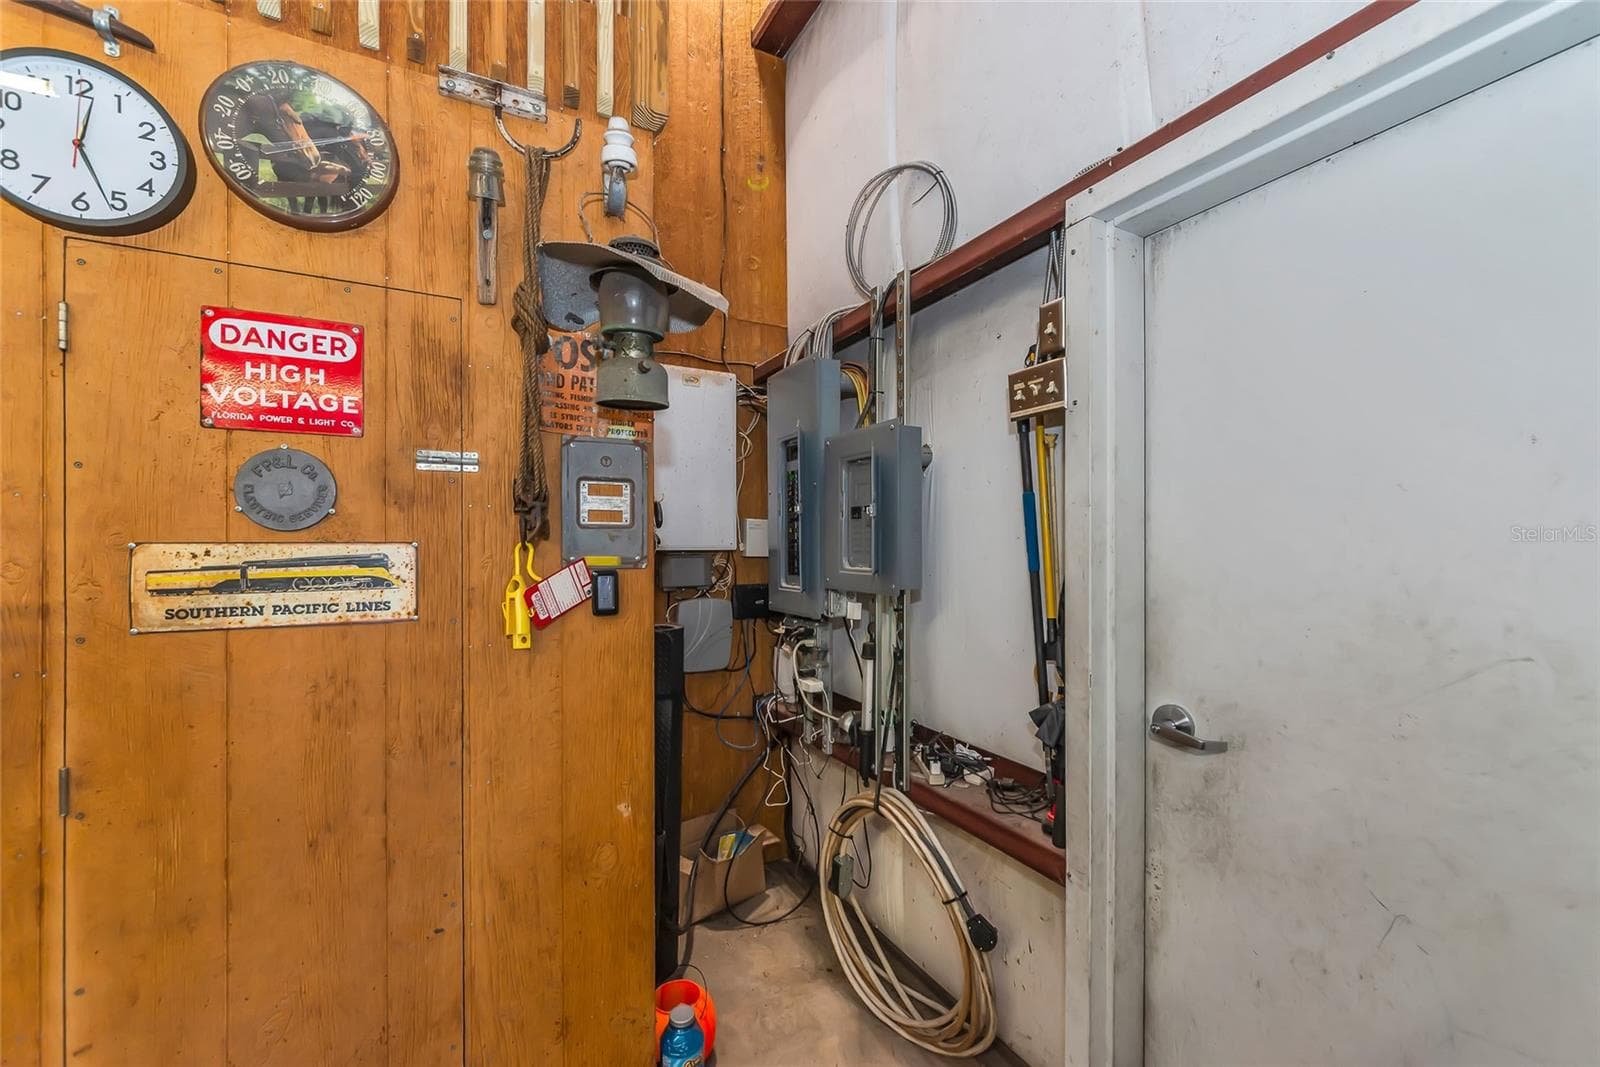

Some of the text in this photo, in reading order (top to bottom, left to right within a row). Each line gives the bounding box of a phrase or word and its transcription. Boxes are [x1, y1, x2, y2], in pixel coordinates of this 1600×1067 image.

[65, 75, 94, 96] 12
[268, 68, 290, 84] 20
[114, 94, 122, 113] 1
[138, 121, 156, 141] 2
[0, 149, 20, 170] 8
[149, 150, 167, 170] 3
[370, 161, 387, 184] 100
[31, 173, 51, 194] 7
[136, 178, 155, 197] 4
[71, 191, 90, 212] 6
[110, 190, 128, 211] 5
[349, 187, 374, 209] 120
[220, 323, 348, 358] DANGER
[244, 361, 326, 386] HIGH
[204, 382, 360, 415] VOLTAGE
[211, 411, 254, 421] FLORIDA
[259, 415, 293, 424] POWER
[309, 418, 336, 427] LIGHT
[164, 600, 392, 621] SOUTHERN PACIFIC LINES
